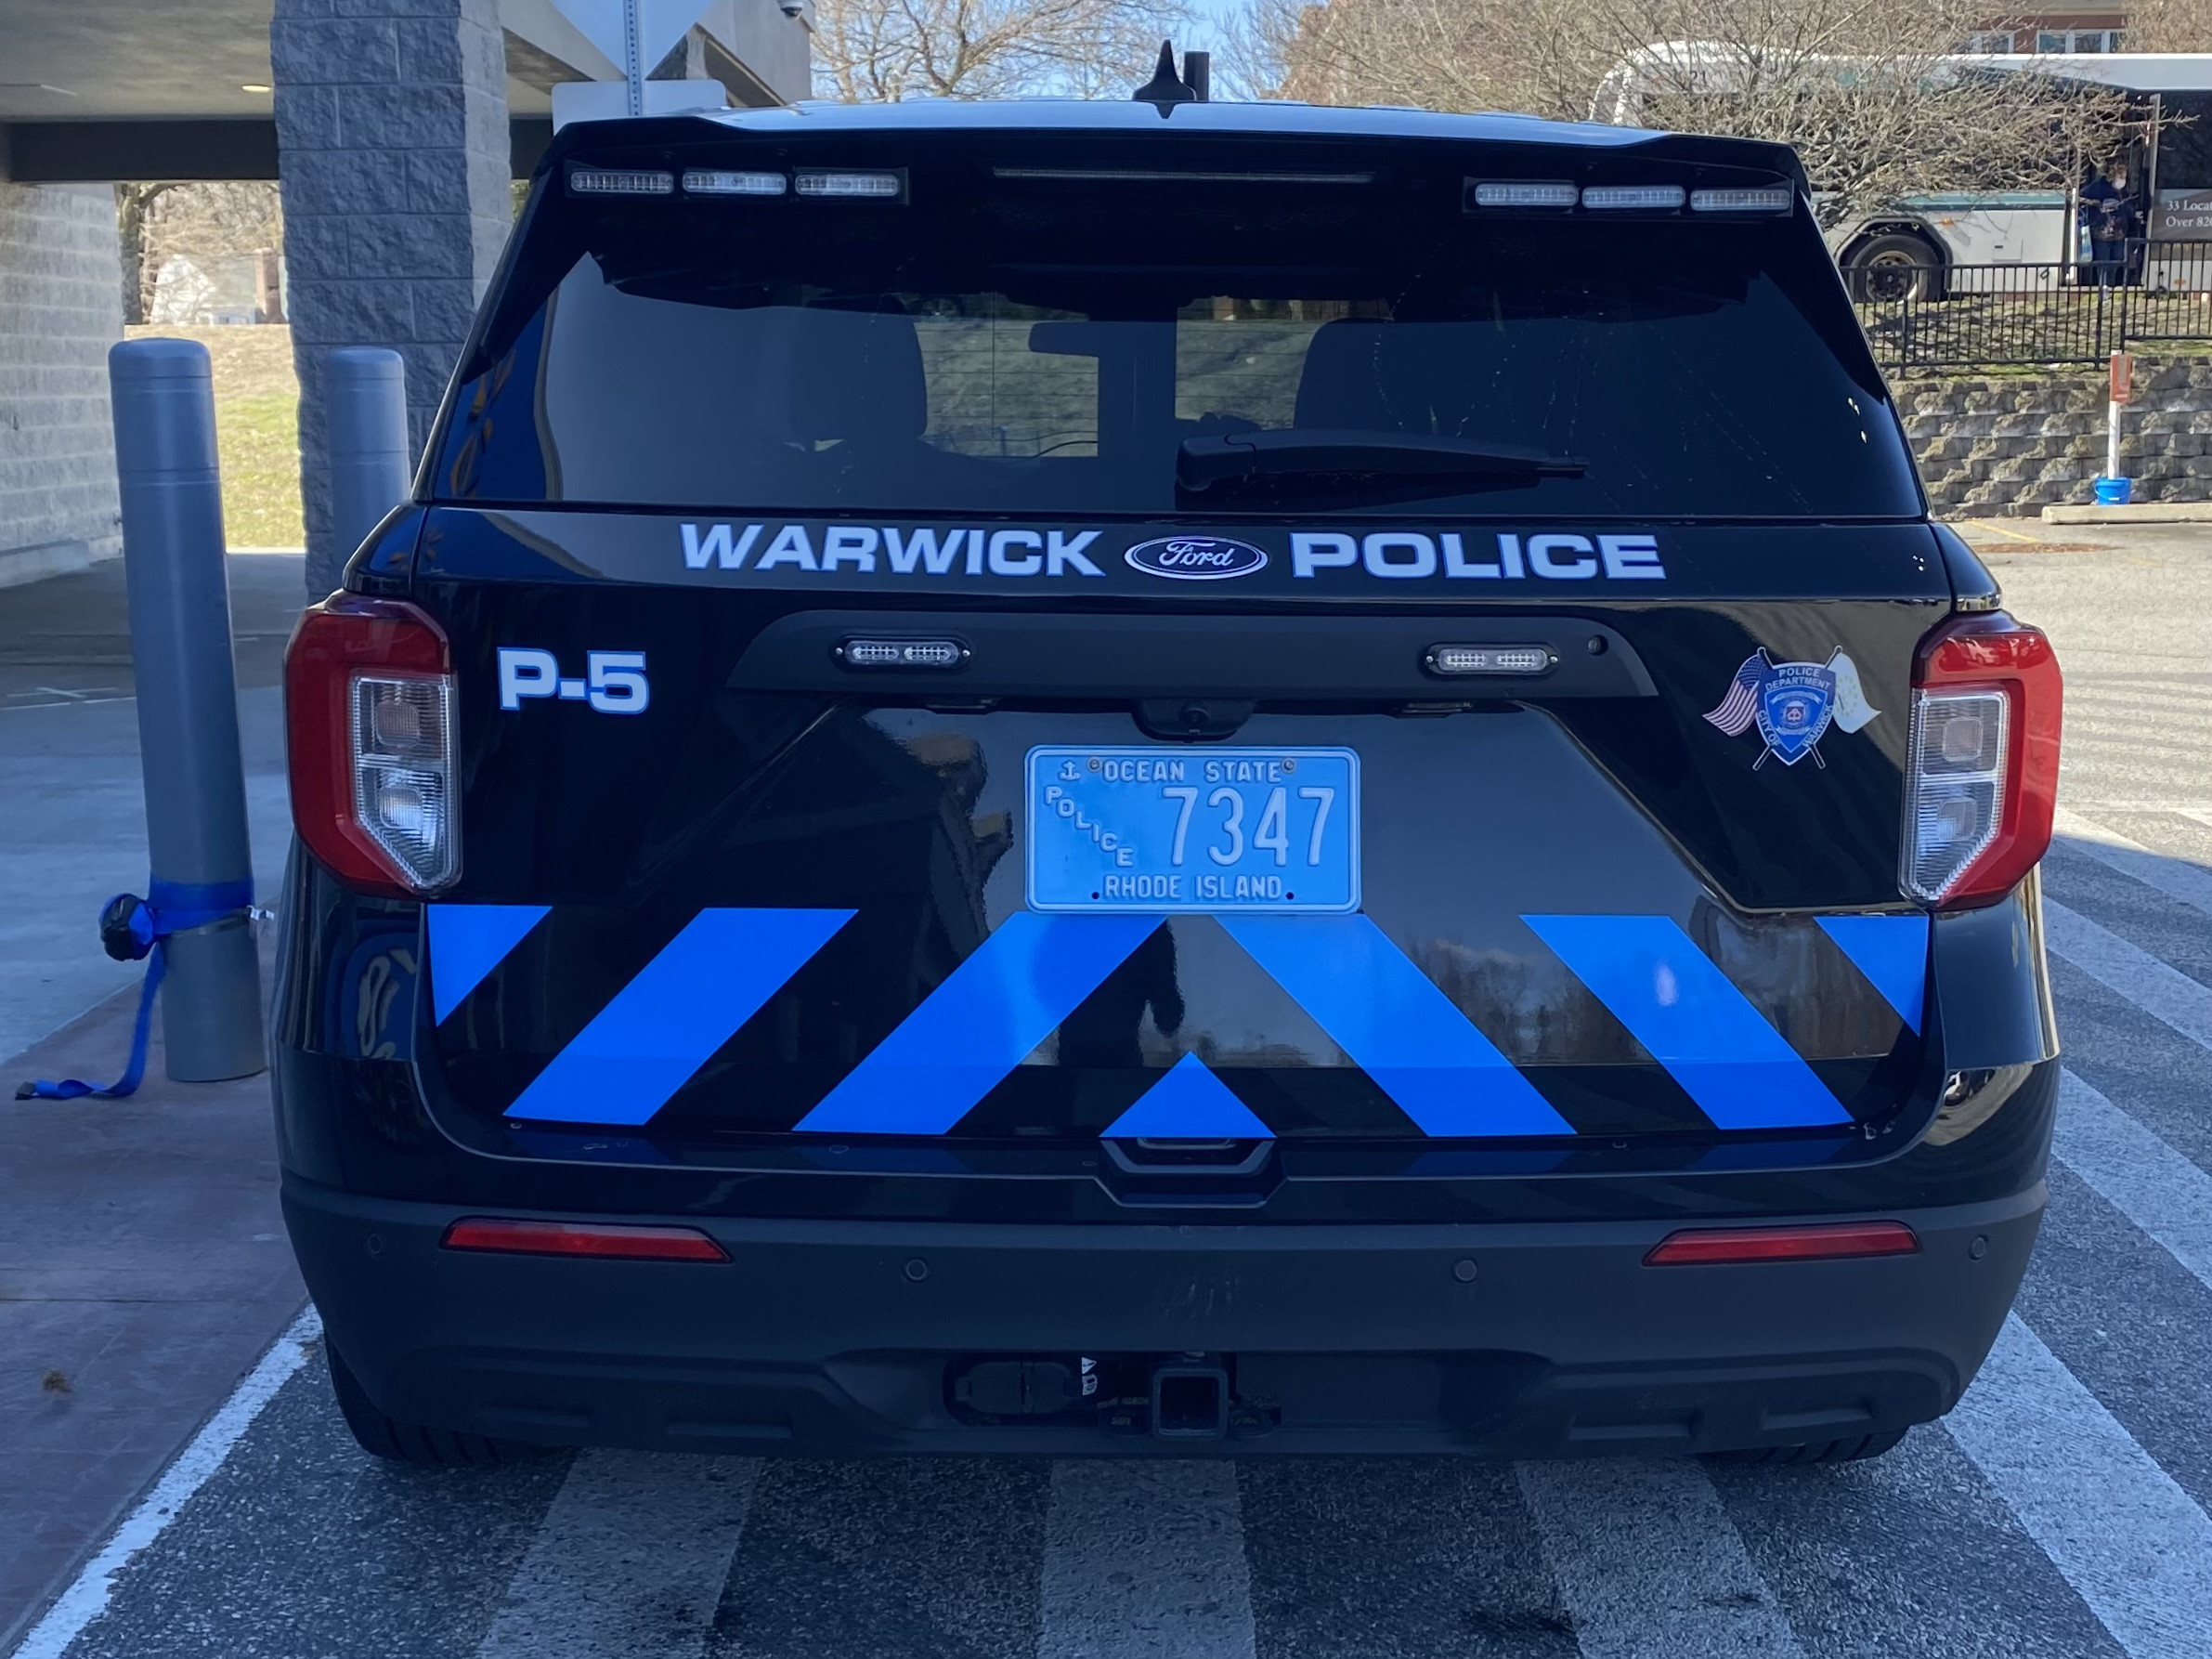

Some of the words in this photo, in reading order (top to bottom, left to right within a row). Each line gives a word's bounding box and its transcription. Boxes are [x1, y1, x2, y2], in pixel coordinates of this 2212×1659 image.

[2166, 200, 2179, 212] 33
[2166, 216, 2193, 228] Over
[681, 523, 1106, 577] WARWICK
[1289, 532, 1667, 579] POLICE
[1159, 541, 1235, 566] Ford
[497, 647, 649, 714] P-5
[1765, 676, 1831, 691] DEPARTMENT
[1778, 667, 1820, 677] POLICE
[1758, 711, 1774, 732] CITY
[1768, 734, 1781, 746] OF
[1802, 703, 1833, 748] WARWICK
[1102, 760, 1184, 782] OCEAN
[1204, 761, 1282, 782] STATE
[1045, 786, 1134, 867] POLICE
[1162, 787, 1334, 866] 7347
[1103, 875, 1181, 899] RHODE
[1195, 875, 1282, 899] ISLAND
